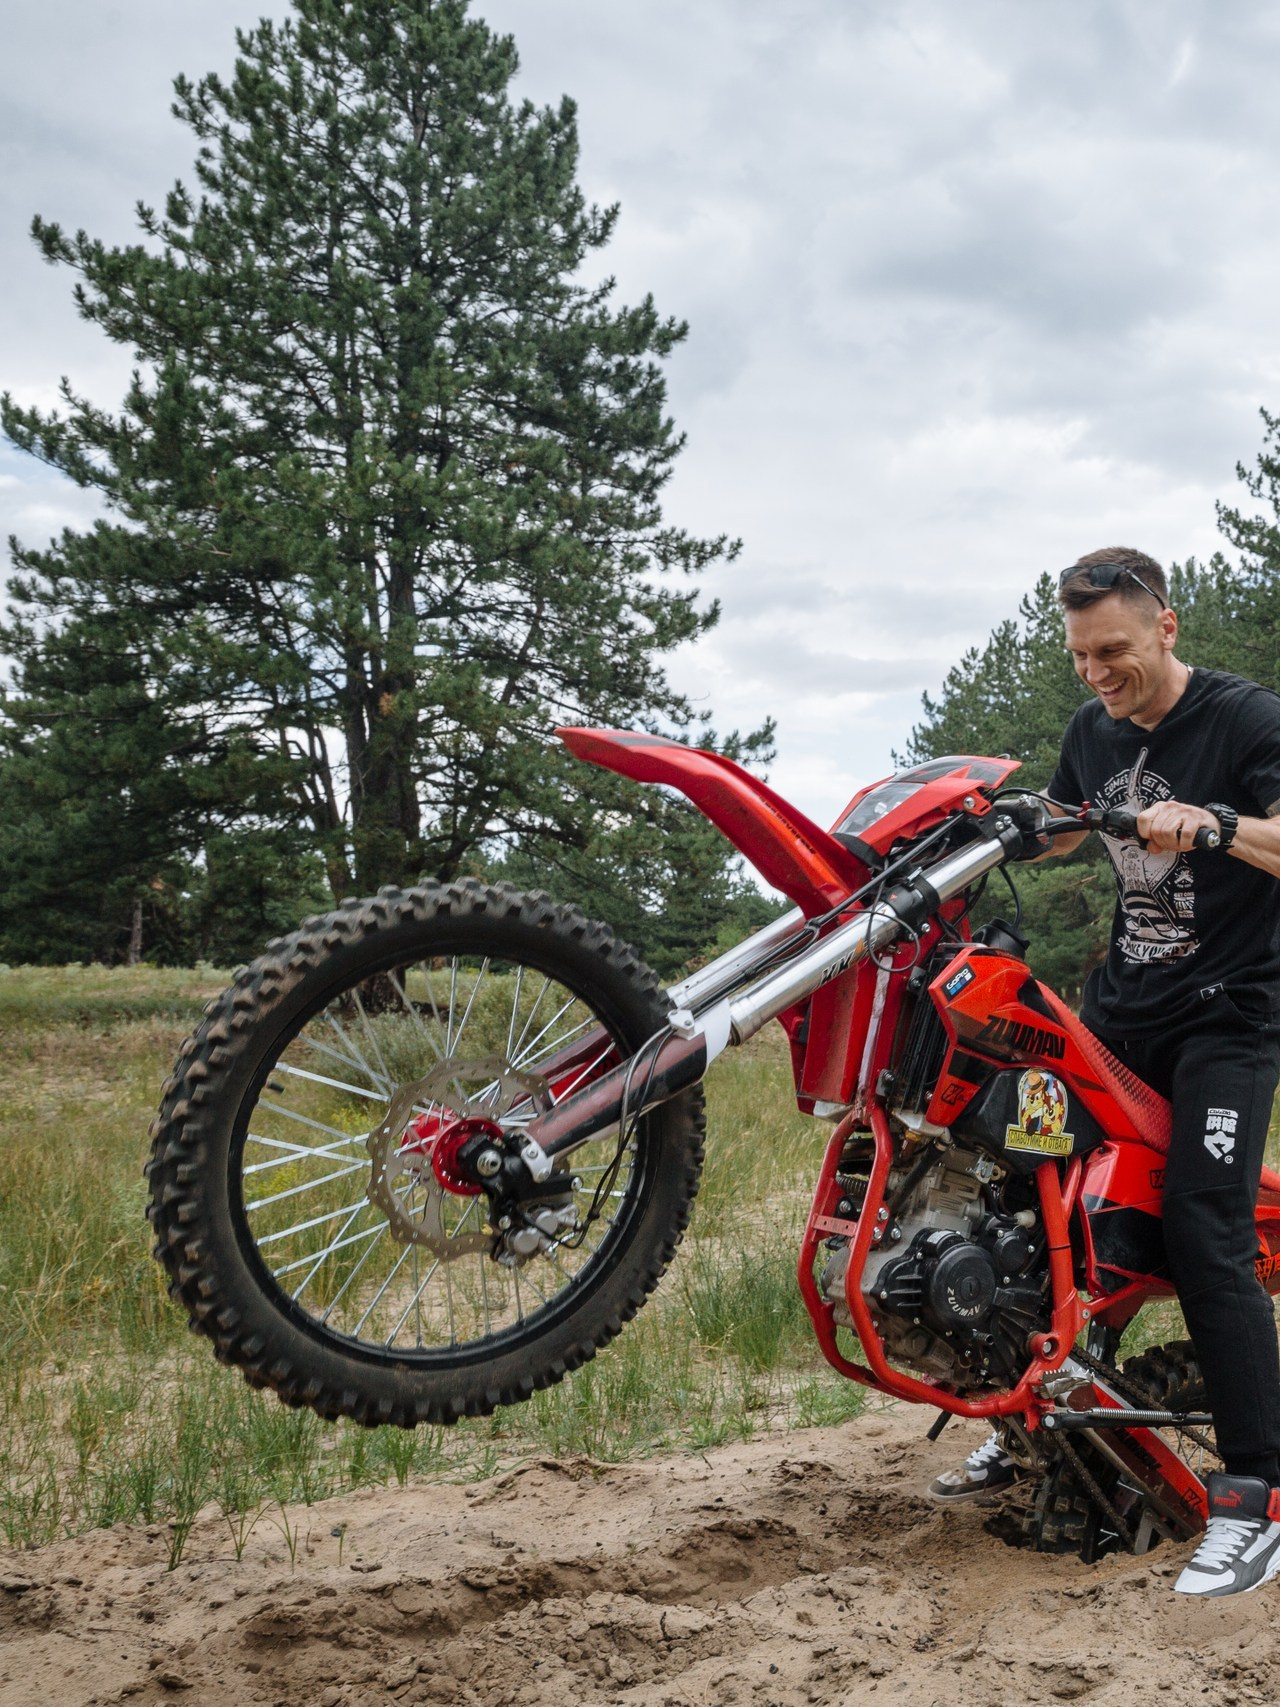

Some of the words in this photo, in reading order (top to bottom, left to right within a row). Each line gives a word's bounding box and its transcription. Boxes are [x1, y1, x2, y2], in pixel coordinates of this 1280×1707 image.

[1142, 775, 1158, 788] GET
[1155, 783, 1171, 799] ME
[946, 968, 968, 990] GoPro
[975, 1014, 1066, 1060] ZUUMAV
[947, 1286, 981, 1317] ZUUMAV
